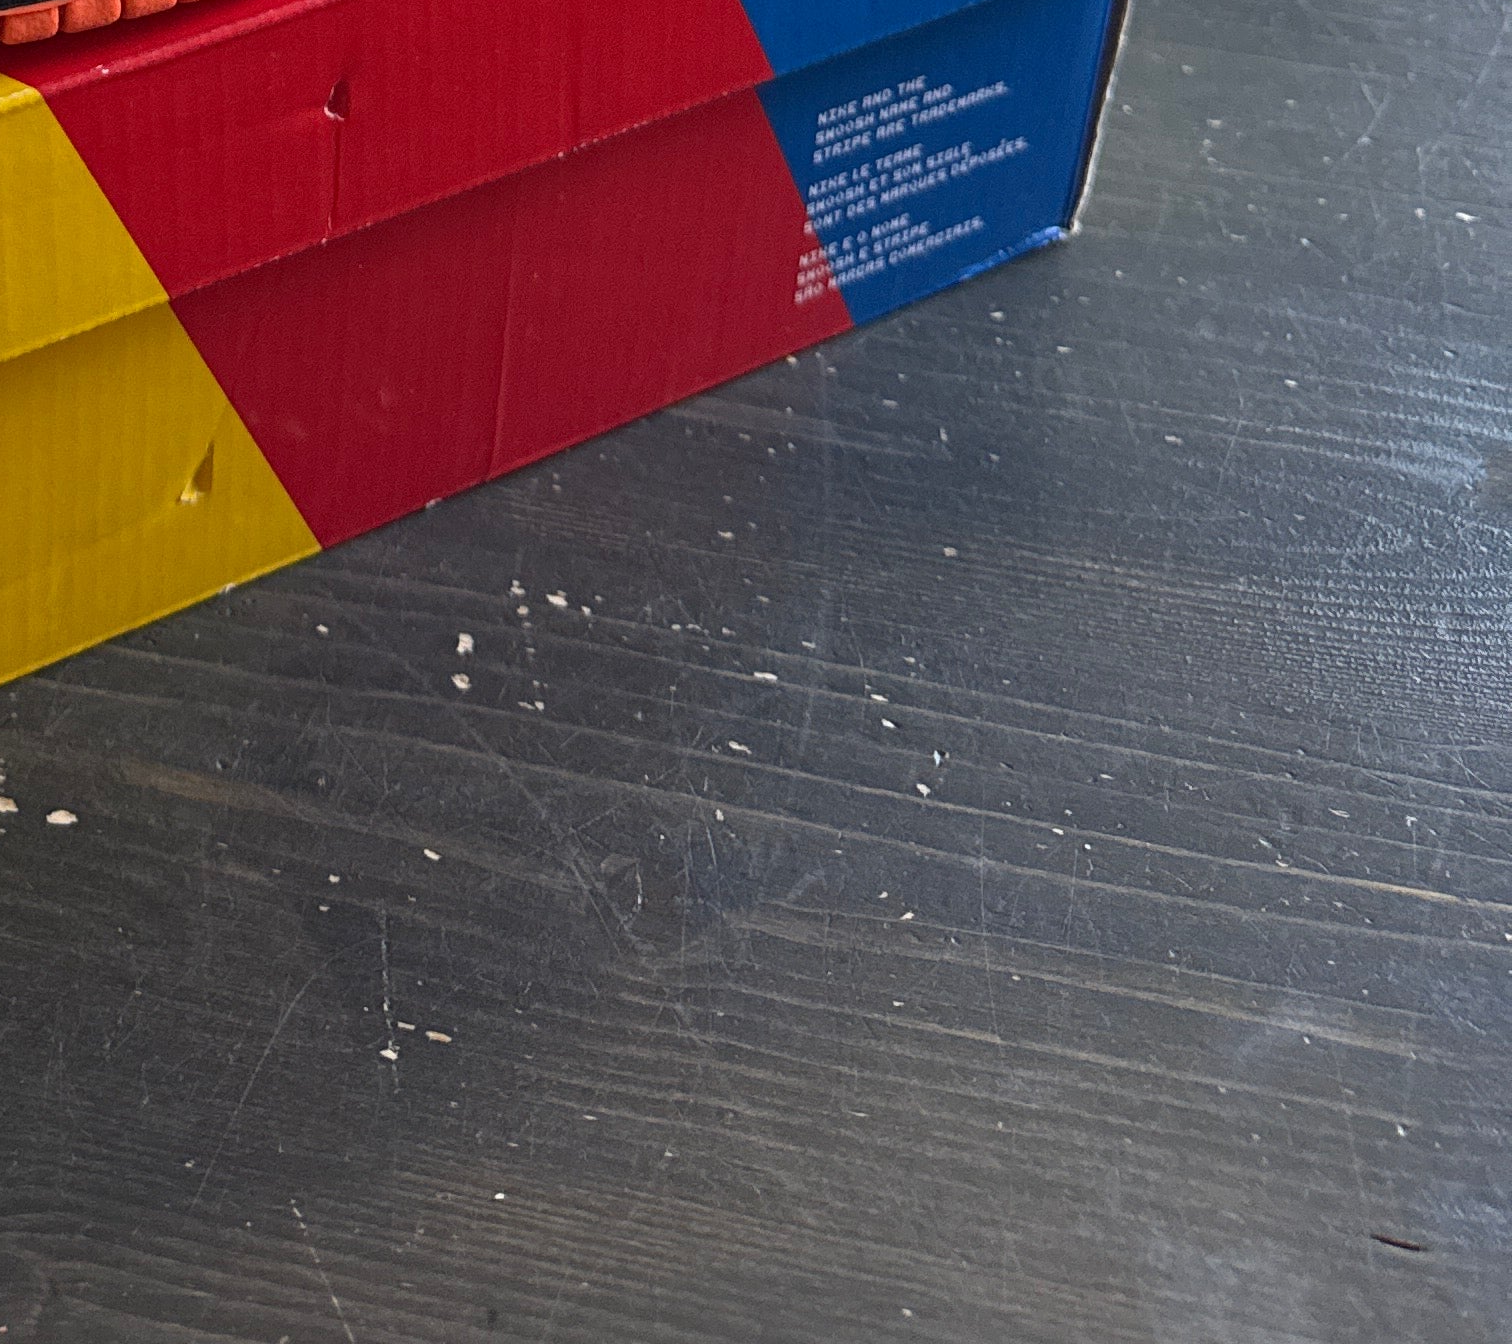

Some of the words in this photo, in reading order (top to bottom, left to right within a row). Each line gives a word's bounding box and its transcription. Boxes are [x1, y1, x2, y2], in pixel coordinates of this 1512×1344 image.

[813, 130, 872, 164] STRIPE
[876, 117, 906, 140] ARE
[910, 80, 1008, 126] TRADEMARKS.
[815, 112, 875, 145] SWOOSH
[879, 96, 918, 121] NAME
[923, 83, 953, 104] AND
[818, 99, 858, 126] NIKE
[862, 87, 892, 109] AND
[897, 74, 927, 96] THE
[804, 209, 843, 235] SONT
[846, 195, 877, 218] DES
[880, 167, 948, 204] MARQUES
[806, 183, 866, 217] SWOOSH
[869, 173, 889, 192] ET
[893, 161, 923, 182] SON
[926, 140, 972, 168] SIGLE
[808, 171, 848, 198] NIKE
[851, 162, 871, 181] LE
[876, 142, 923, 170] TERME
[796, 251, 855, 287] SWOOSH
[858, 245, 870, 261] E
[873, 220, 930, 254] STRIPE
[799, 241, 838, 267] NIKE
[842, 235, 854, 251] E
[857, 230, 869, 245] O
[871, 212, 911, 239] NOME
[827, 255, 886, 289] MARCAS
